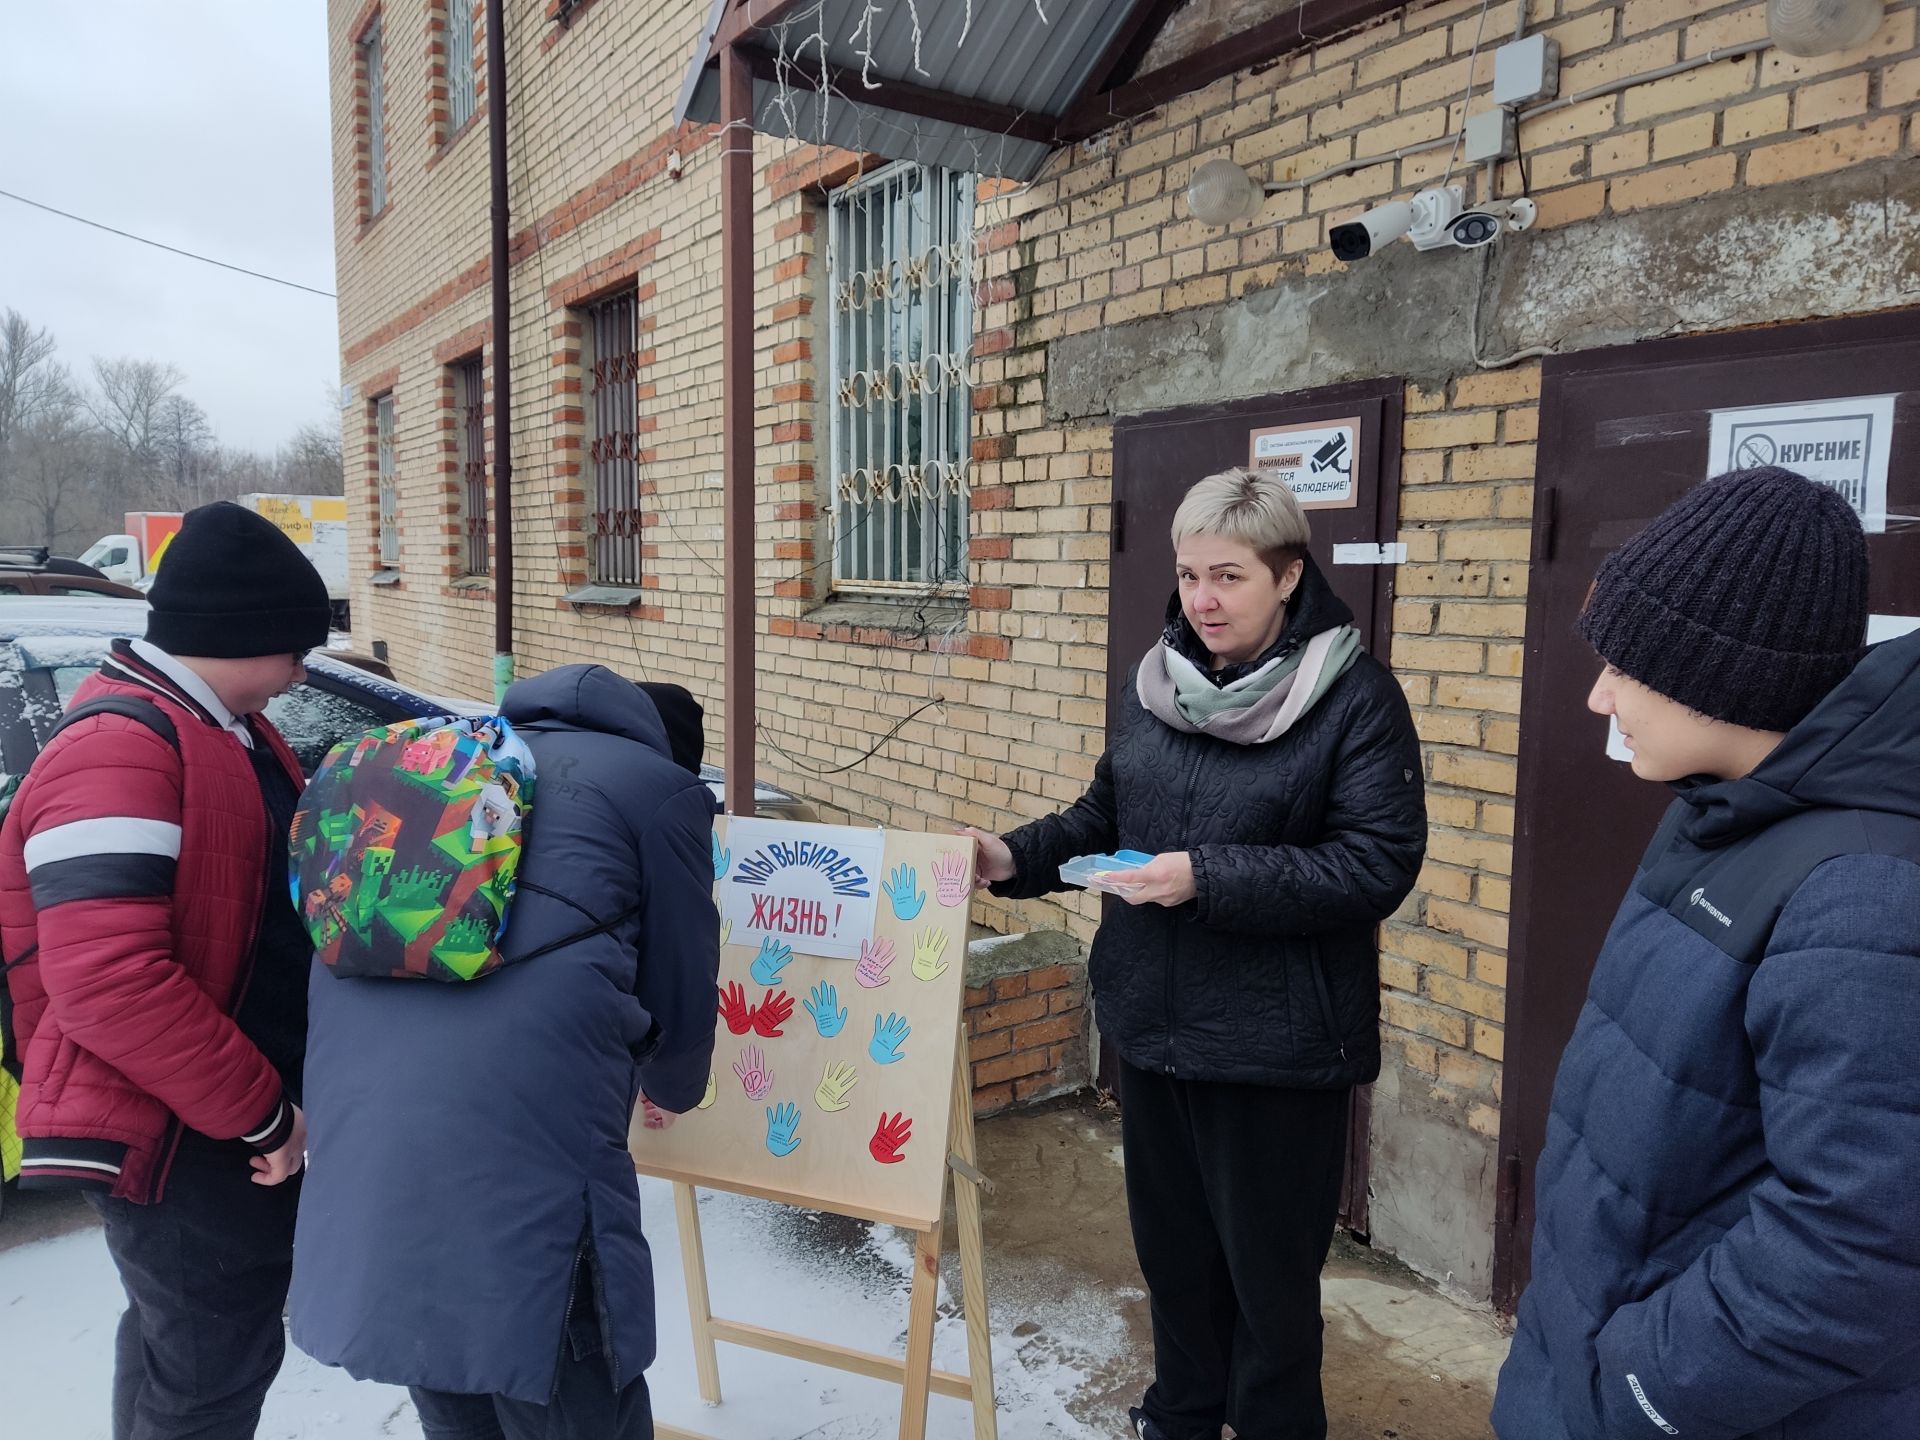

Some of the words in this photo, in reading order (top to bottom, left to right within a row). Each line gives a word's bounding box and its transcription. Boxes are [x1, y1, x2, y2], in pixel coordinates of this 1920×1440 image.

[1258, 456, 1301, 468] ВНИМАНИЕ
[1780, 440, 1861, 463] КУРЕНИЕ
[1290, 481, 1348, 493] АБЛЮДЕНИЕ!
[732, 849, 778, 886] МЫ
[767, 841, 870, 898] ВЫБИРАЕМ
[1699, 898, 1733, 927] OUTVENTURE
[1642, 1402, 1661, 1421] DRY
